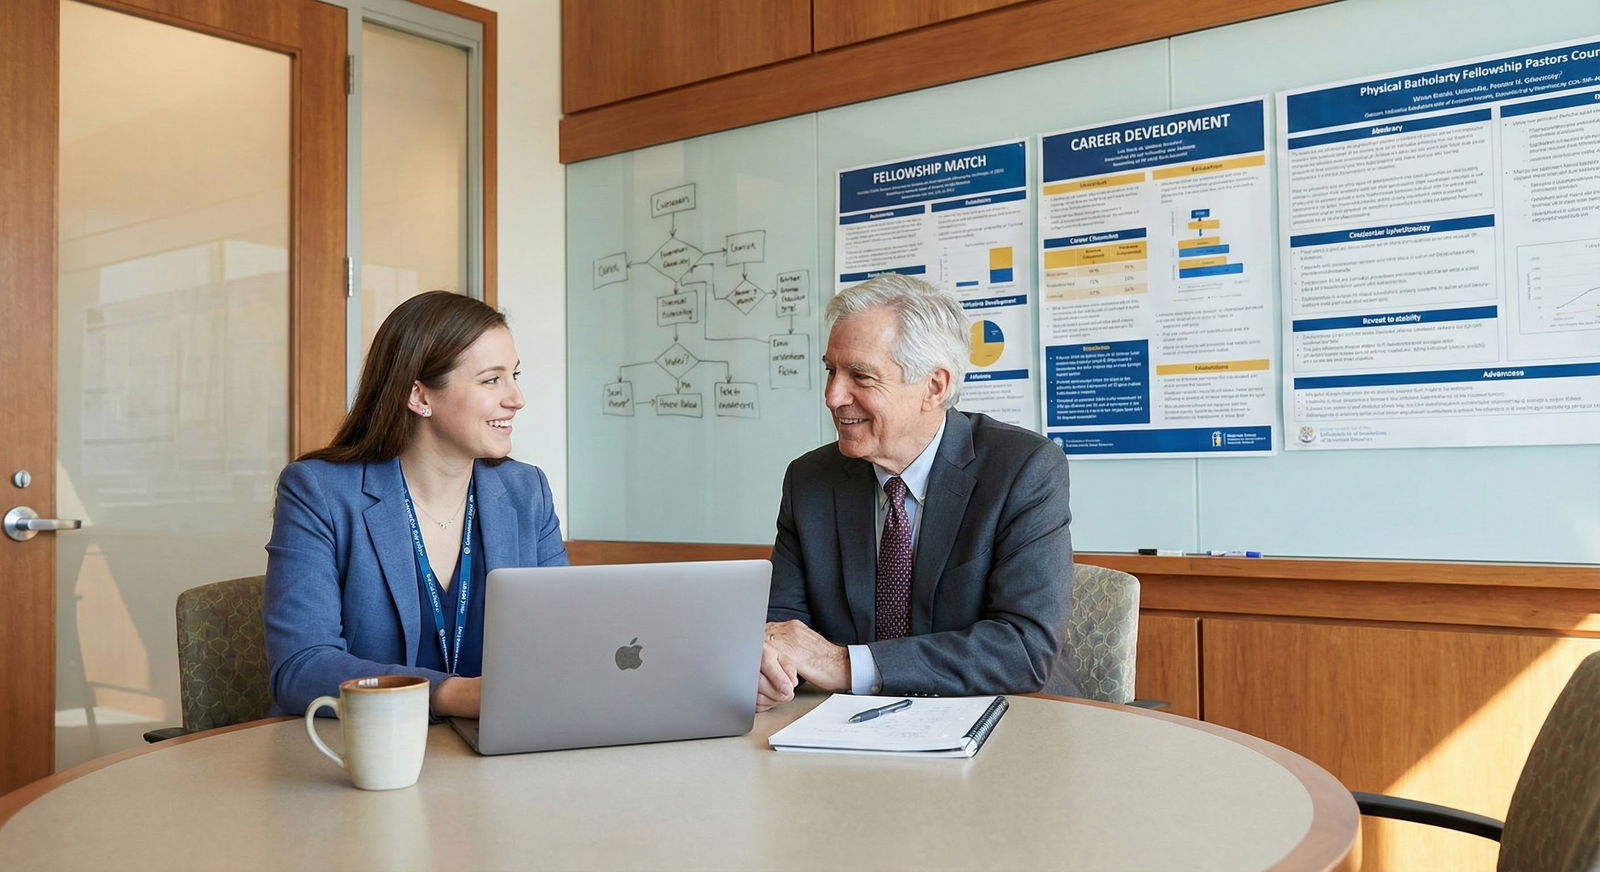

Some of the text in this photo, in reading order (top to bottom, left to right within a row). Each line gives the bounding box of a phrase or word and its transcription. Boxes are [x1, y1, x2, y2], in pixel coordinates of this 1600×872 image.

[1360, 76, 1402, 97] Physical
[1404, 71, 1461, 90] Batholarty
[1462, 61, 1523, 80] Fellowship
[1525, 54, 1568, 69] Pastors
[1070, 113, 1231, 151] CAREER DEVELOPMENT
[873, 162, 942, 184] FELLOWSHIP
[944, 155, 987, 173] MATCH
